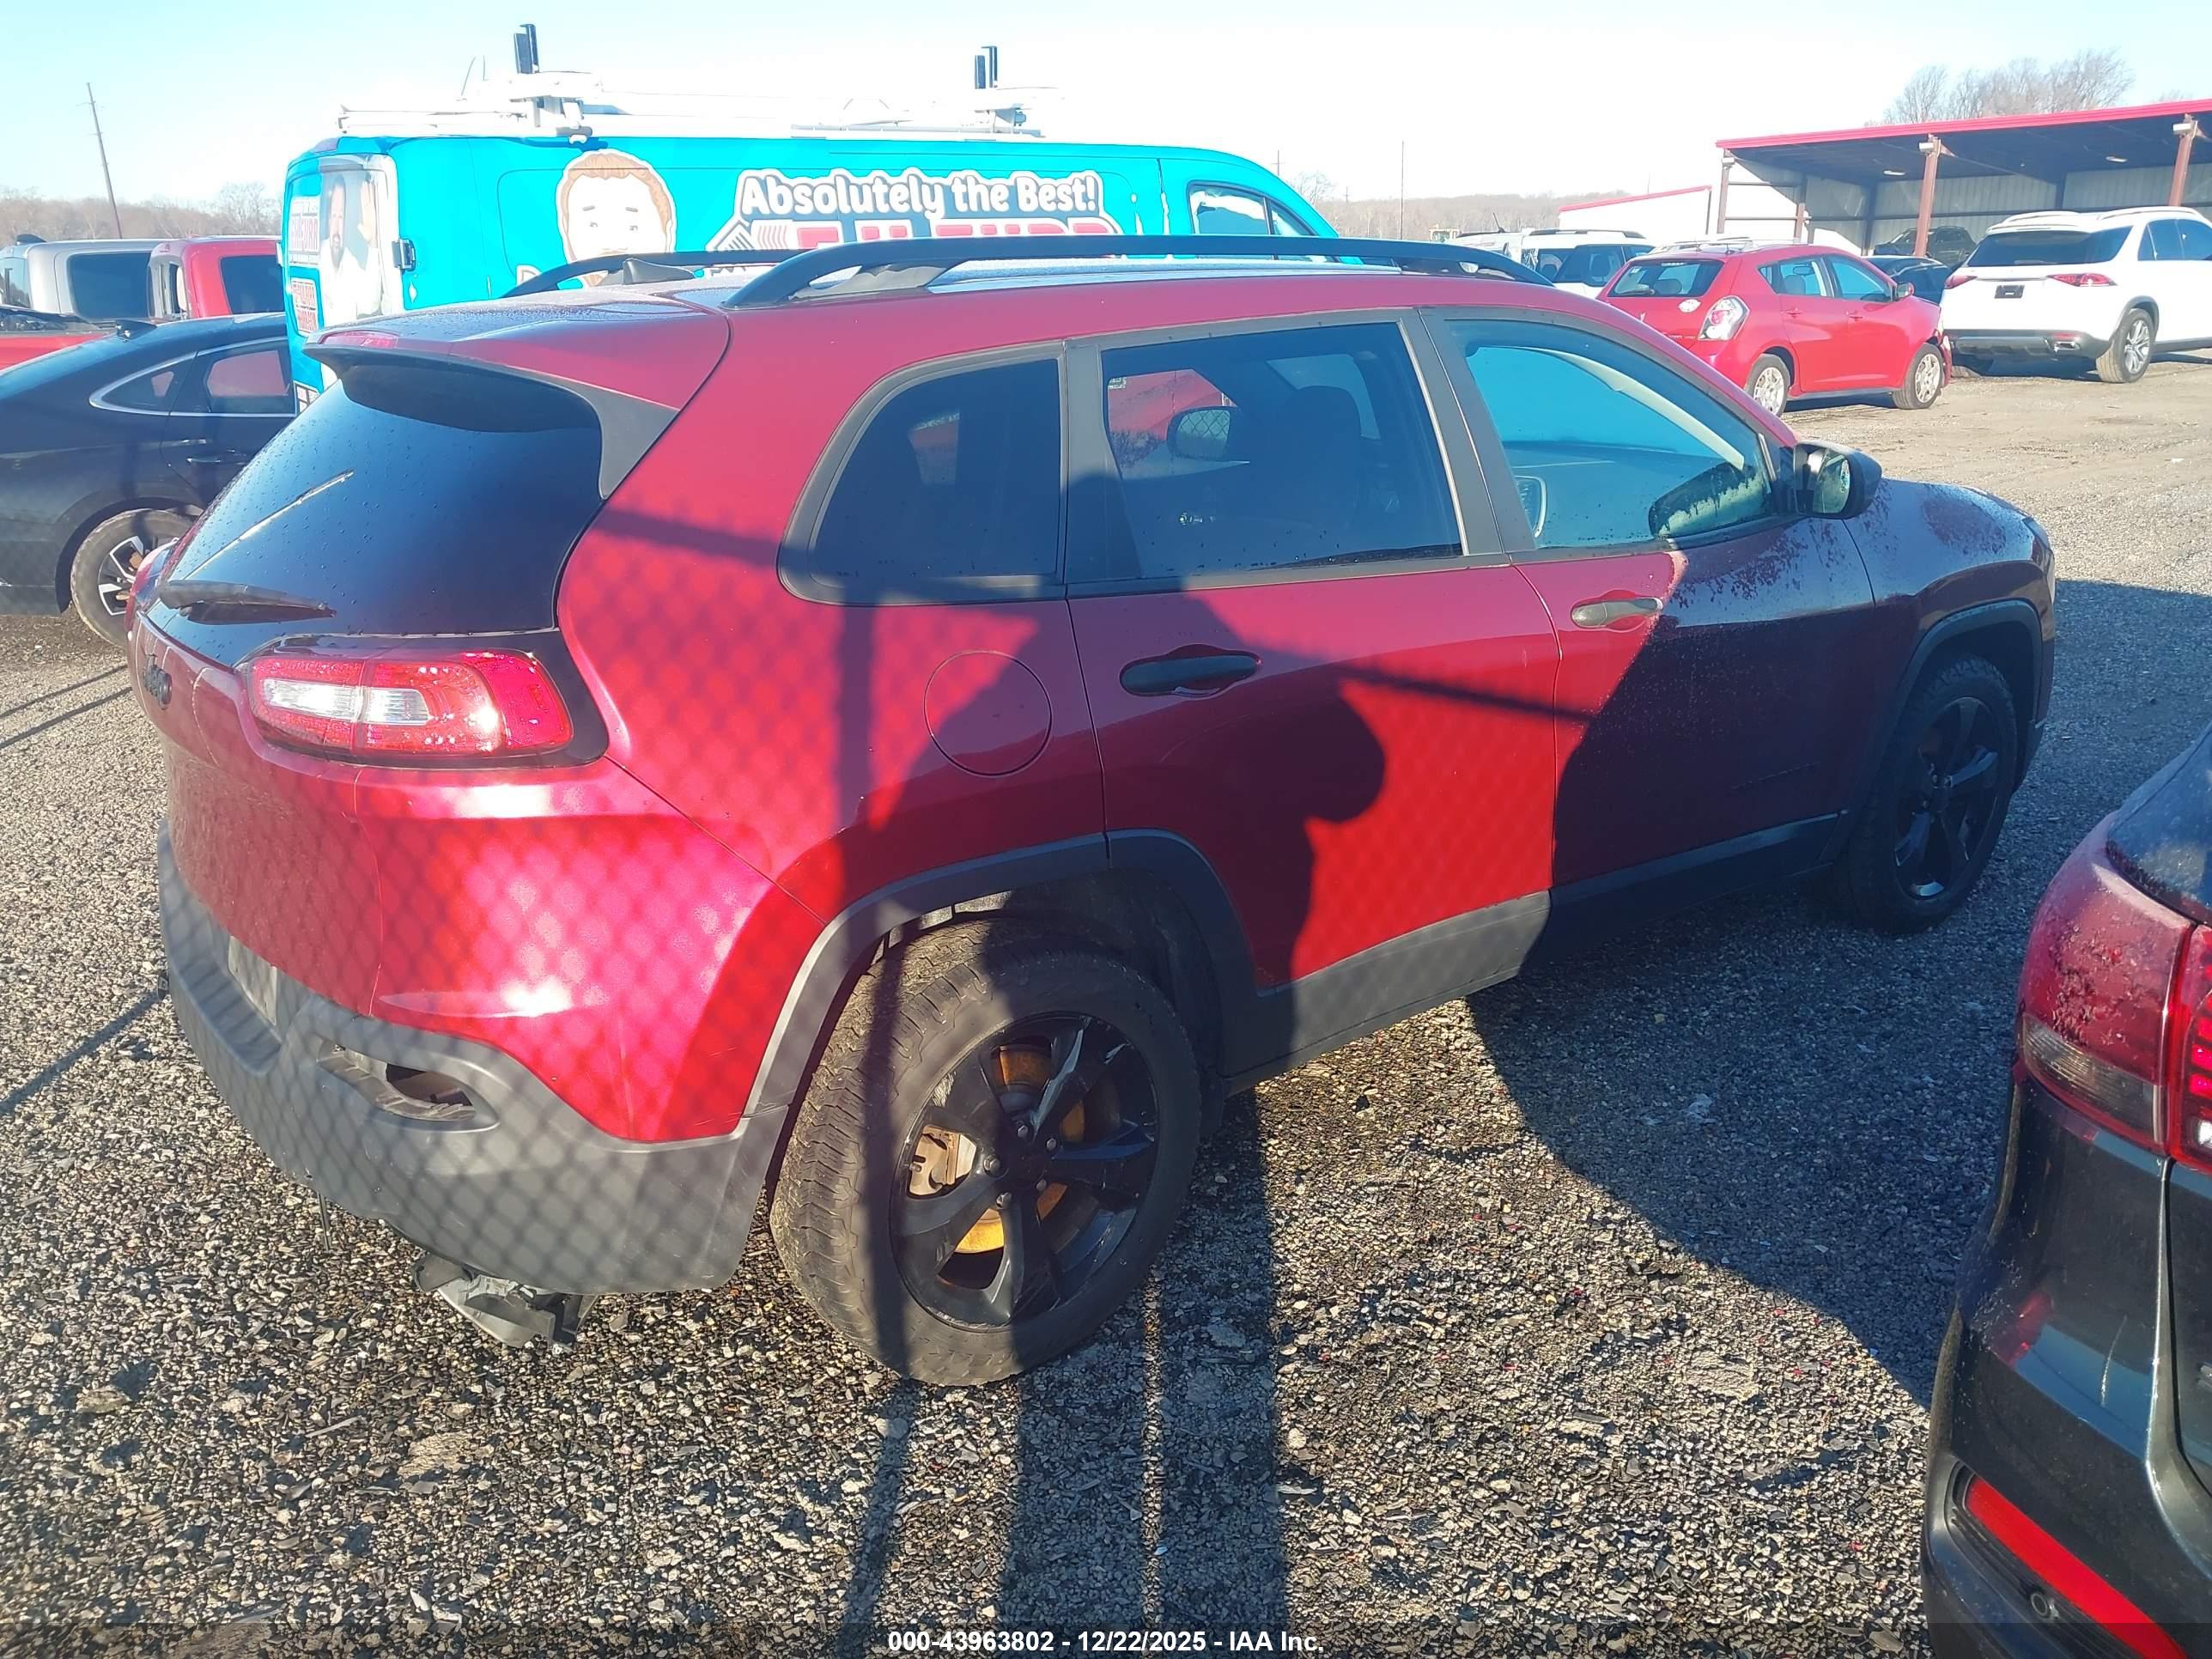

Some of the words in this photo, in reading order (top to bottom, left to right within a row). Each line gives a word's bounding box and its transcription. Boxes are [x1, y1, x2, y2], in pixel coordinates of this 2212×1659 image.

[740, 174, 945, 219] Absolutely
[951, 175, 1009, 212] the
[1017, 175, 1097, 212] Best!
